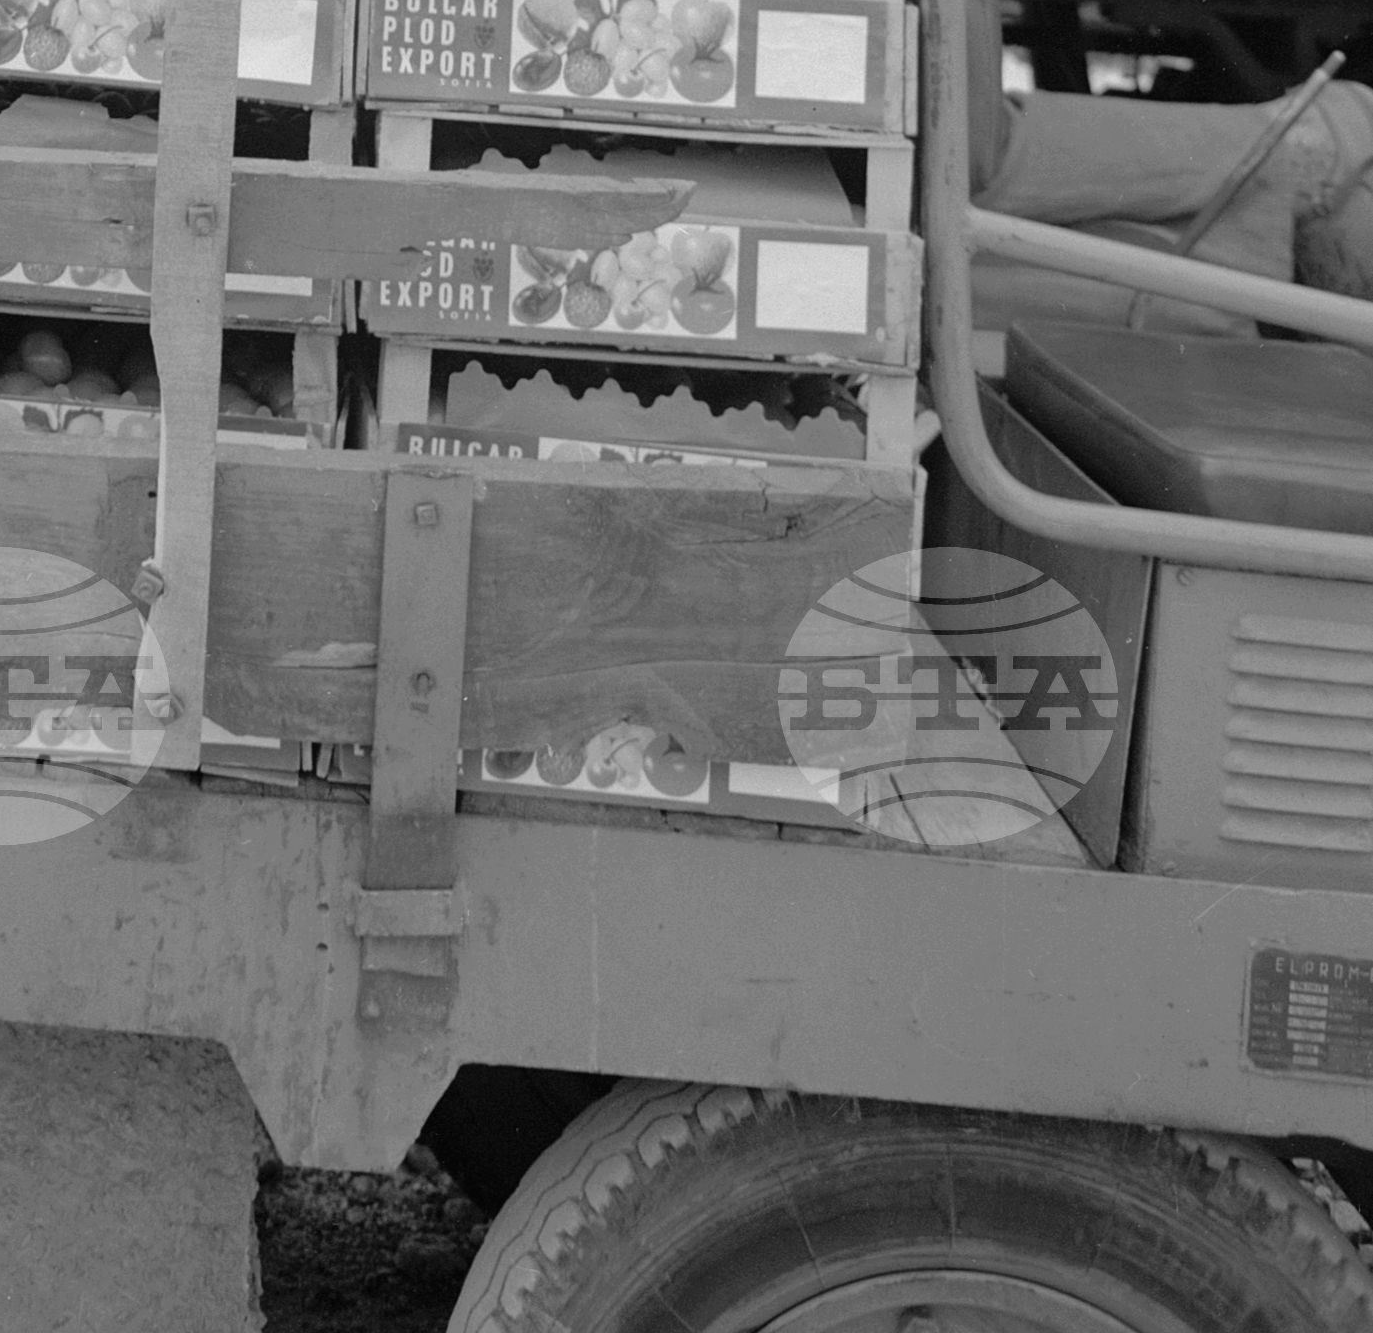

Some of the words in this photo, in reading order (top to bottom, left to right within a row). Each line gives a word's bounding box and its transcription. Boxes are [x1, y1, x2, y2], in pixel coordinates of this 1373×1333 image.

[382, 15, 456, 46] PLOD
[381, 45, 496, 79] EXPORT
[379, 280, 495, 312] EXPORT
